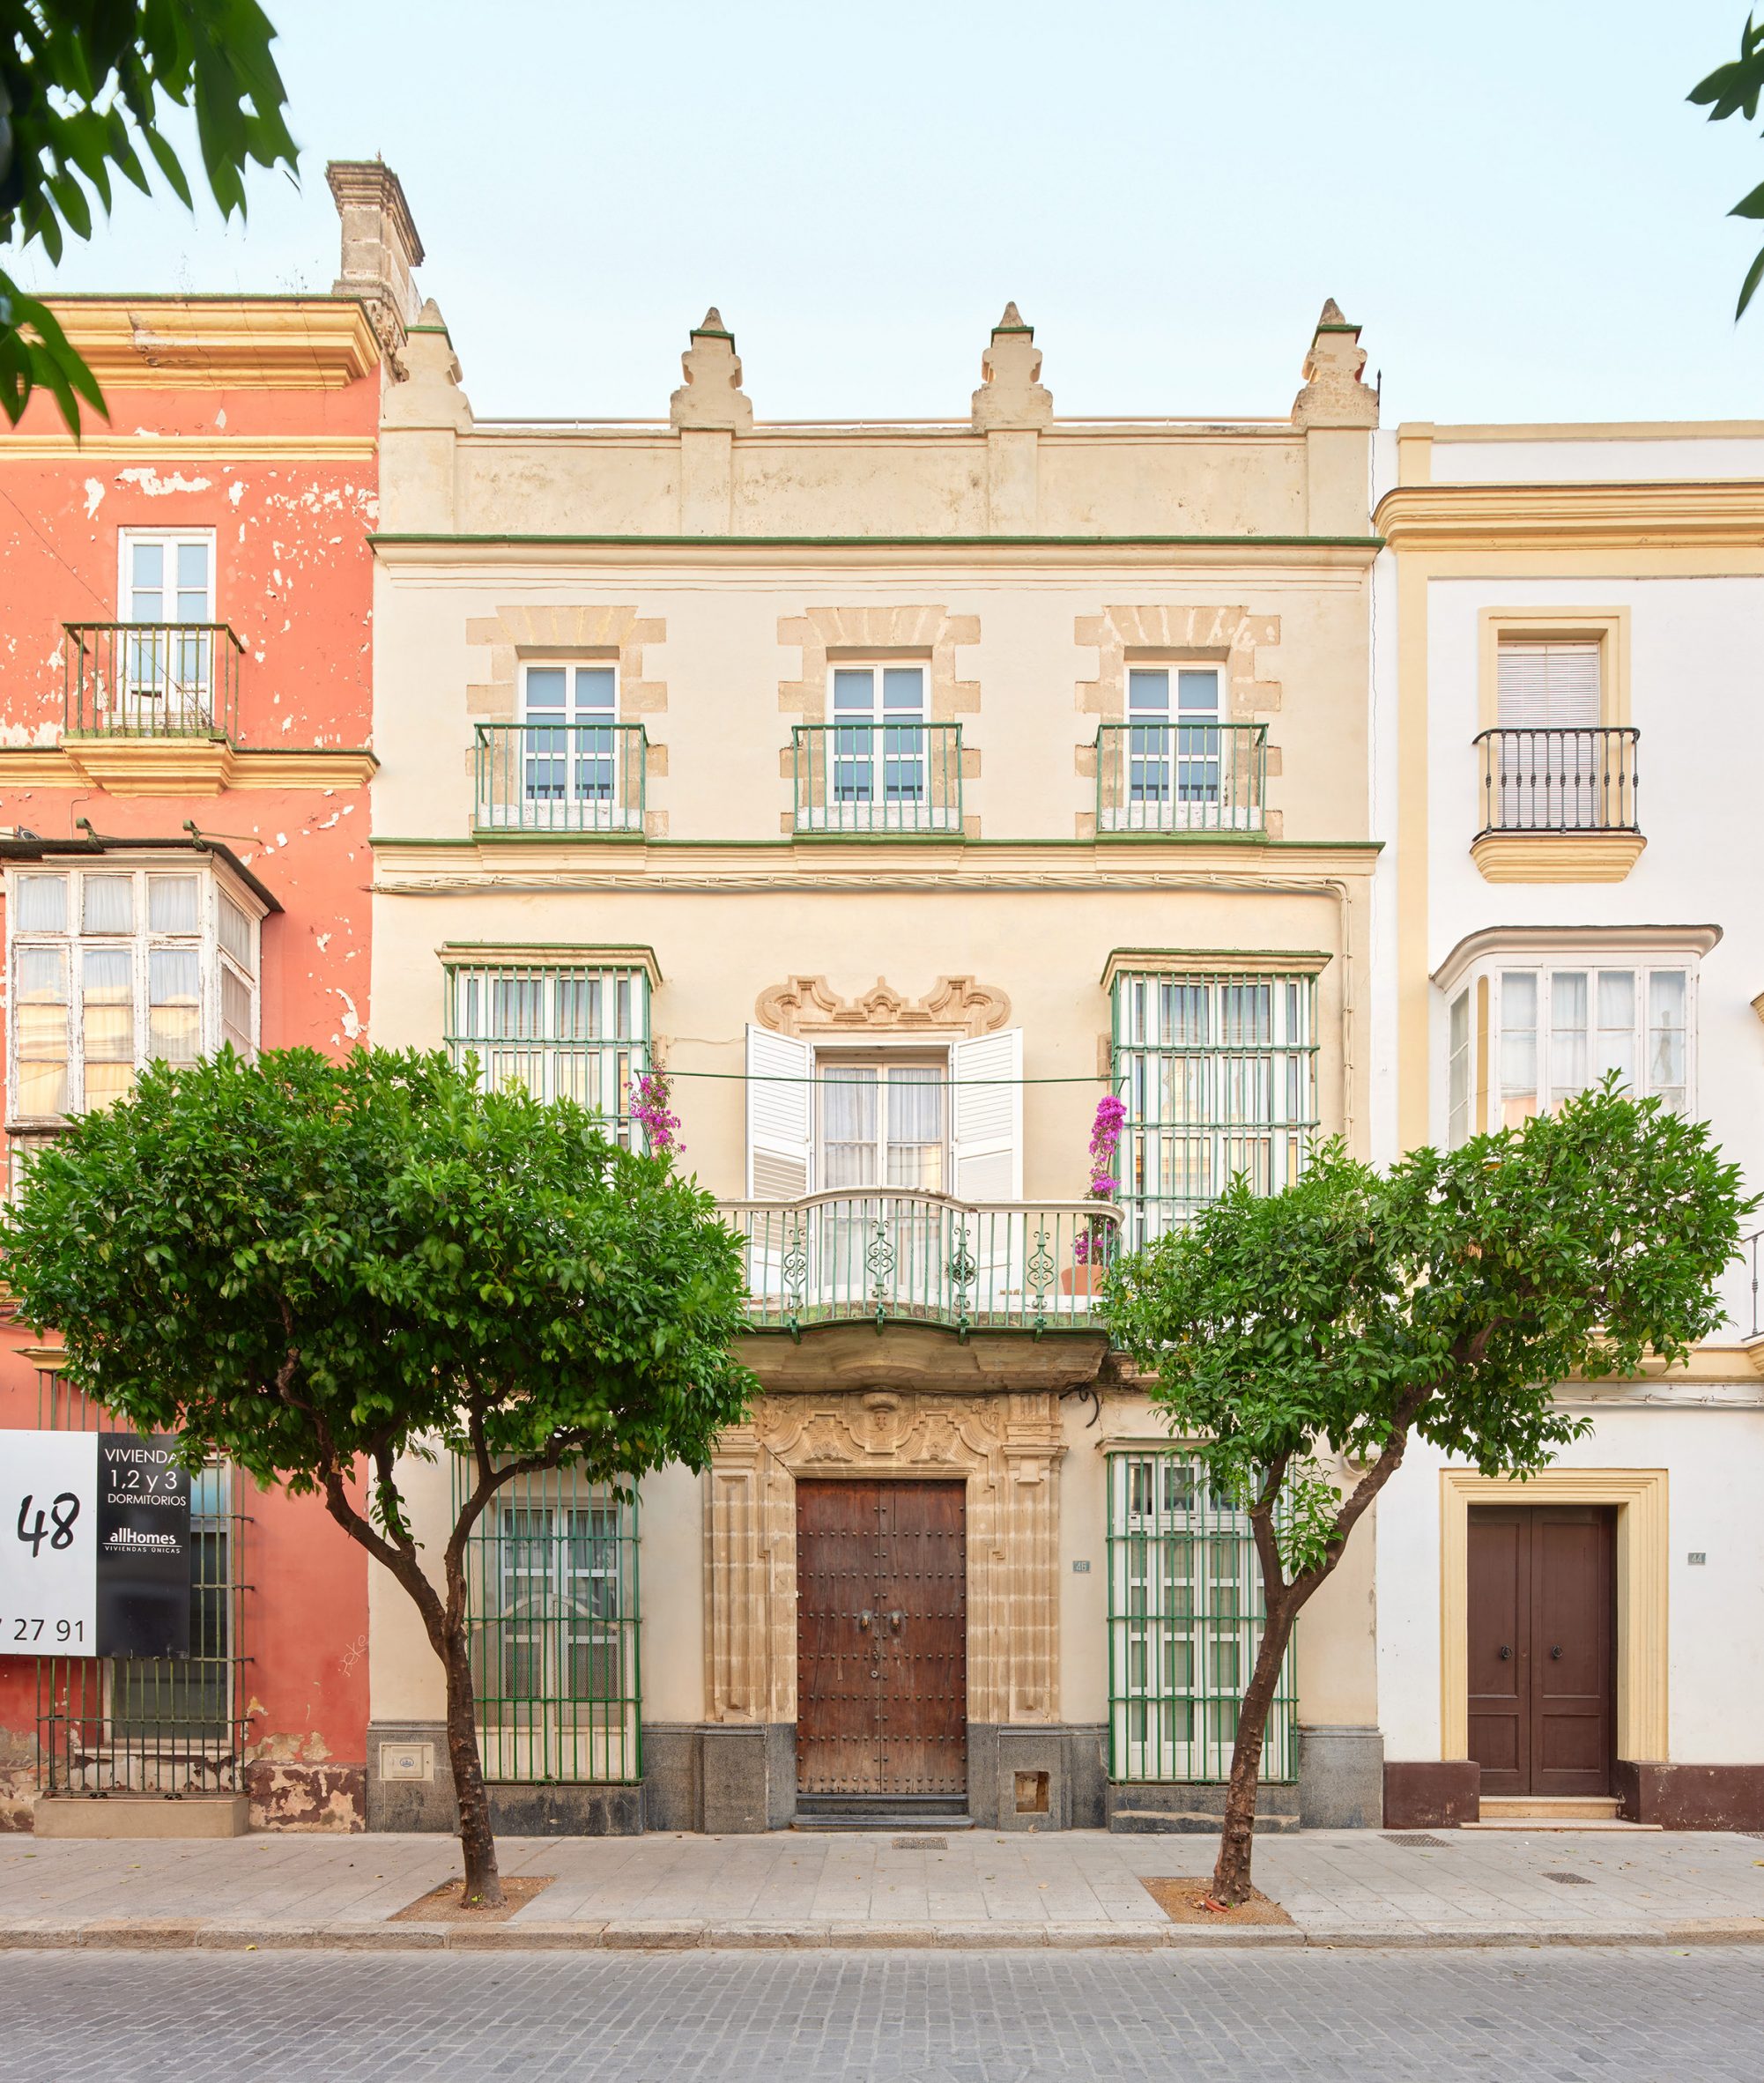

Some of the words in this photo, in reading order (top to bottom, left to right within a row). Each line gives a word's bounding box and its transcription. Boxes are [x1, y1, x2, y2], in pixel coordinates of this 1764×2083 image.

[110, 1469, 140, 1490] 1,2
[145, 1474, 159, 1494] y
[164, 1471, 178, 1490] 3
[107, 1493, 187, 1507] DORMITORIOS
[17, 1492, 80, 1559] 48
[109, 1527, 176, 1546] allHomes
[104, 1545, 148, 1553] VIVIENDAS
[13, 1618, 45, 1641] 27
[56, 1619, 85, 1642] 91
